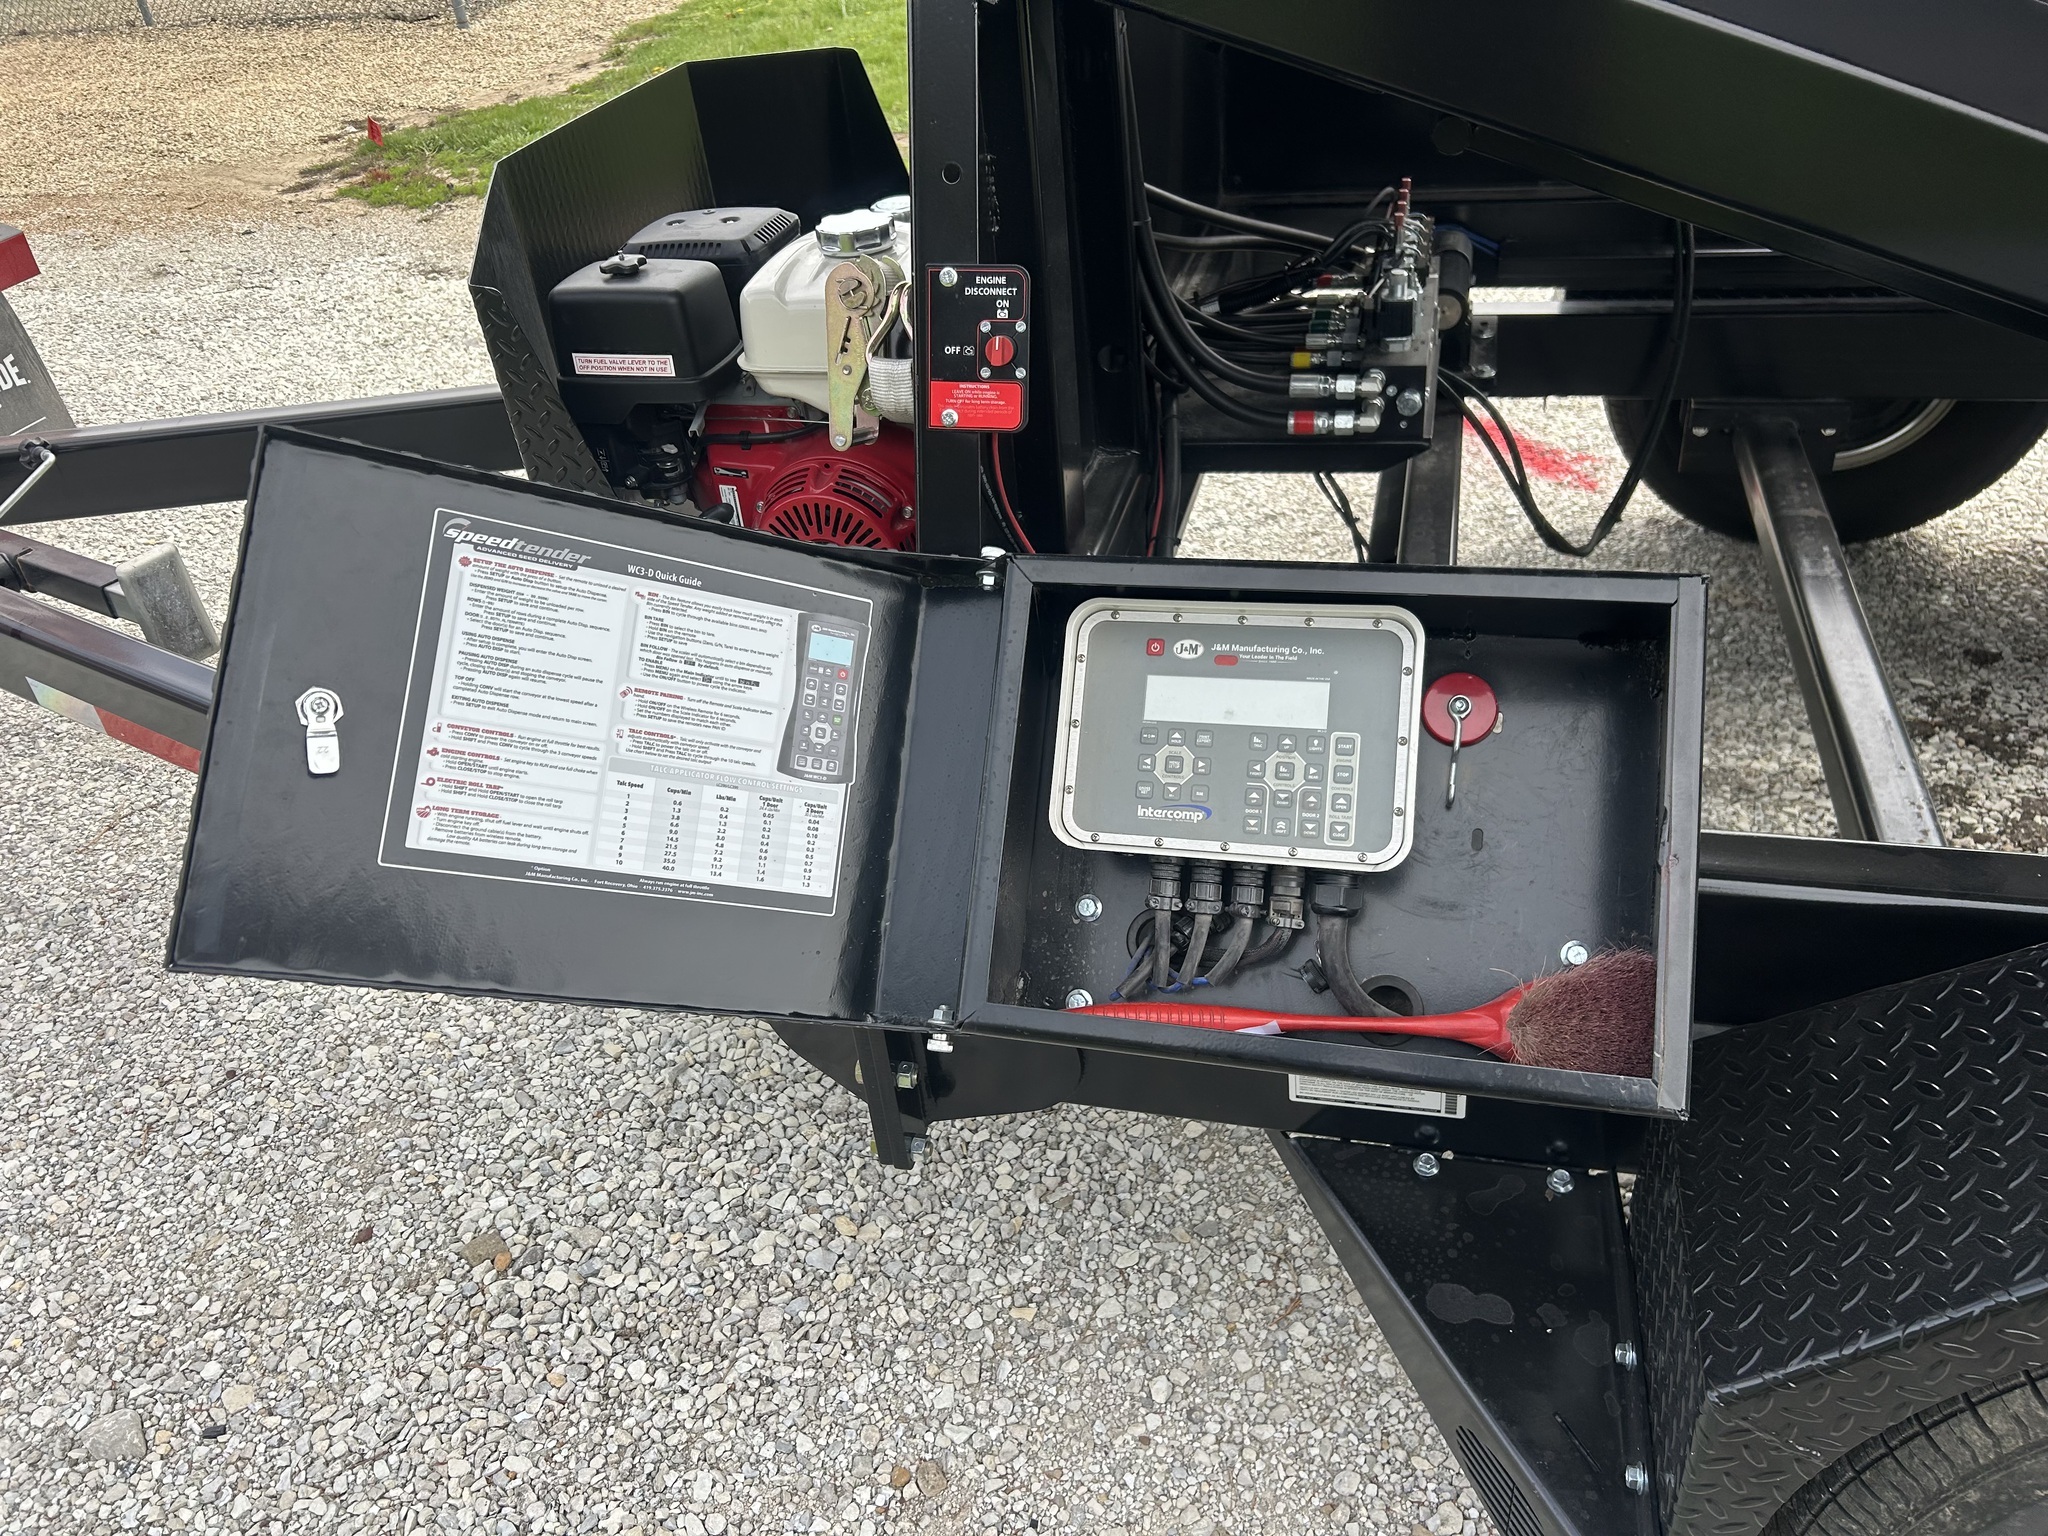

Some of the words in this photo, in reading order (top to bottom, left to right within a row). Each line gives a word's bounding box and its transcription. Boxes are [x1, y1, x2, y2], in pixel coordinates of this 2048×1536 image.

[945, 346, 960, 354] OFF
[476, 545, 516, 557] ADVANCED
[518, 554, 537, 562] SEED
[538, 558, 573, 569] DELIVERY
[473, 557, 492, 565] SETUP
[524, 567, 554, 578] DISPENSE
[626, 564, 654, 578] WC3-D
[654, 569, 677, 582] Quick
[678, 574, 702, 587] Guide
[1176, 644, 1199, 656] J&M
[1232, 644, 1290, 654] Manufacturing
[1292, 646, 1307, 655] Co.,
[634, 687, 658, 696] REMOTE
[447, 723, 480, 732] CONVEYOR
[481, 728, 513, 738] CONTROLS
[466, 751, 500, 760] CONTROLS
[437, 776, 467, 785] ELECTRIC
[650, 764, 668, 773] TALC
[669, 767, 714, 780] APPLICATOR
[715, 774, 736, 783] FLOW
[737, 777, 770, 788] CONTROL
[771, 782, 803, 793] SETTINGS
[666, 787, 691, 796] Cups/Min
[758, 795, 783, 803] Cups/Unit
[804, 801, 827, 810] Cups/Unit
[470, 810, 499, 818] STORAGE
[1137, 805, 1203, 823] Intercomp
